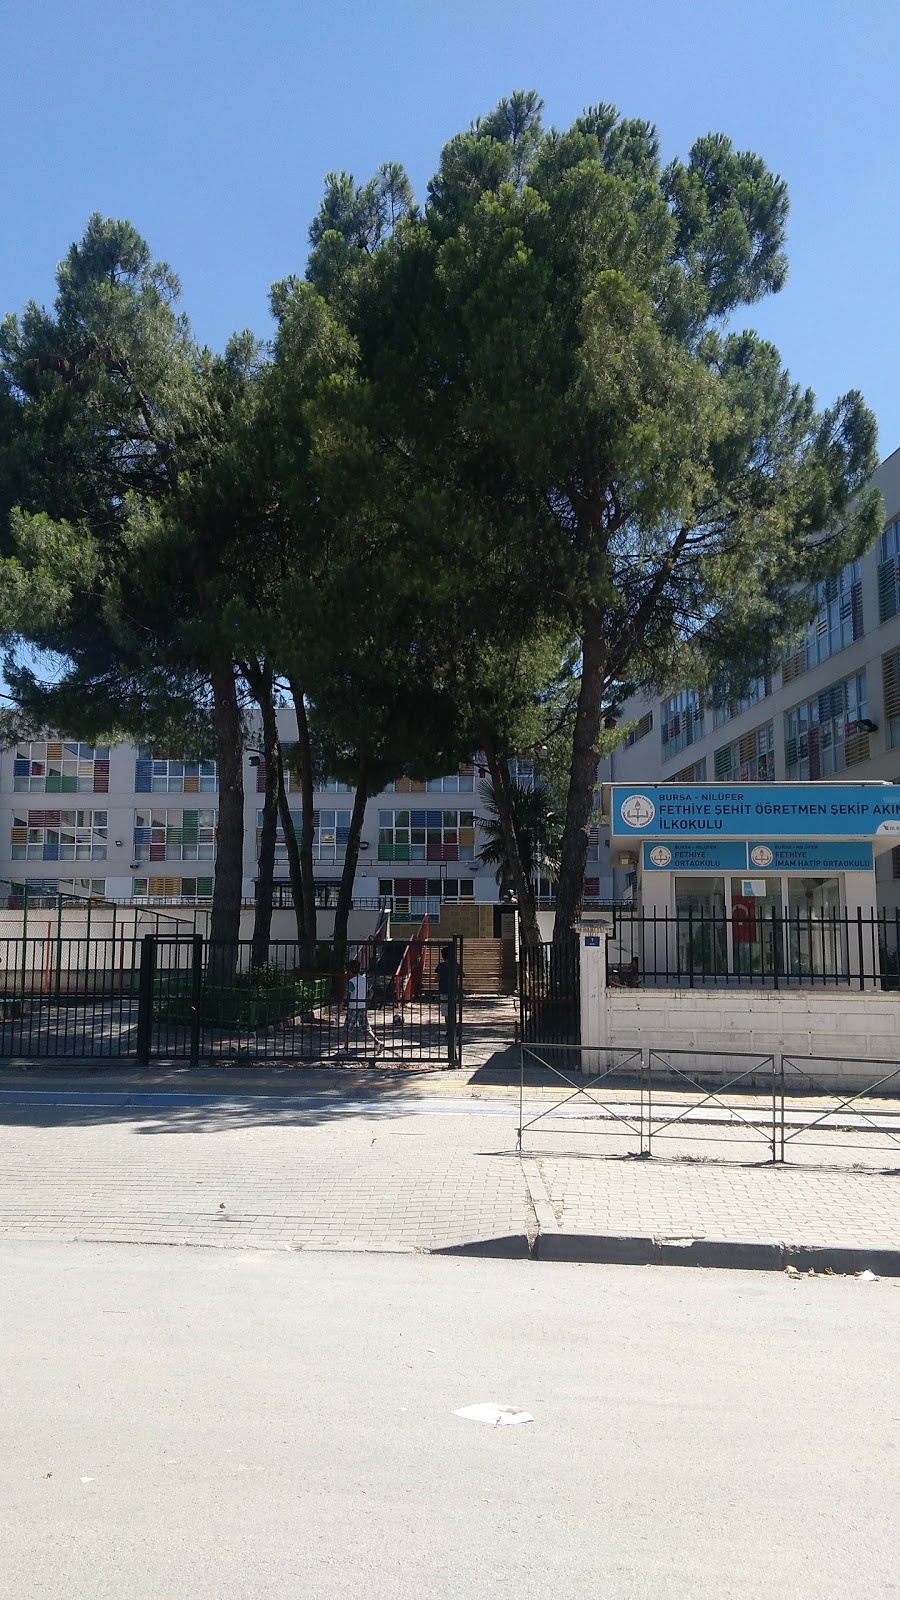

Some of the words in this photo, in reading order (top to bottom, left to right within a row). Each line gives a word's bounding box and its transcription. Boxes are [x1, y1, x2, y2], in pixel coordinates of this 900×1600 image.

[702, 792, 743, 800] NİLÜFER
[659, 803, 710, 814] FETHİYE
[714, 803, 751, 816] ŞEHİT
[755, 802, 826, 814] ÖĞRETMEN
[830, 802, 869, 816] ŞEKİP
[659, 817, 722, 829] İLKOKULU
[674, 859, 721, 867] ORTAOKULU
[775, 858, 797, 867] İMAM
[798, 858, 822, 867] HATİP
